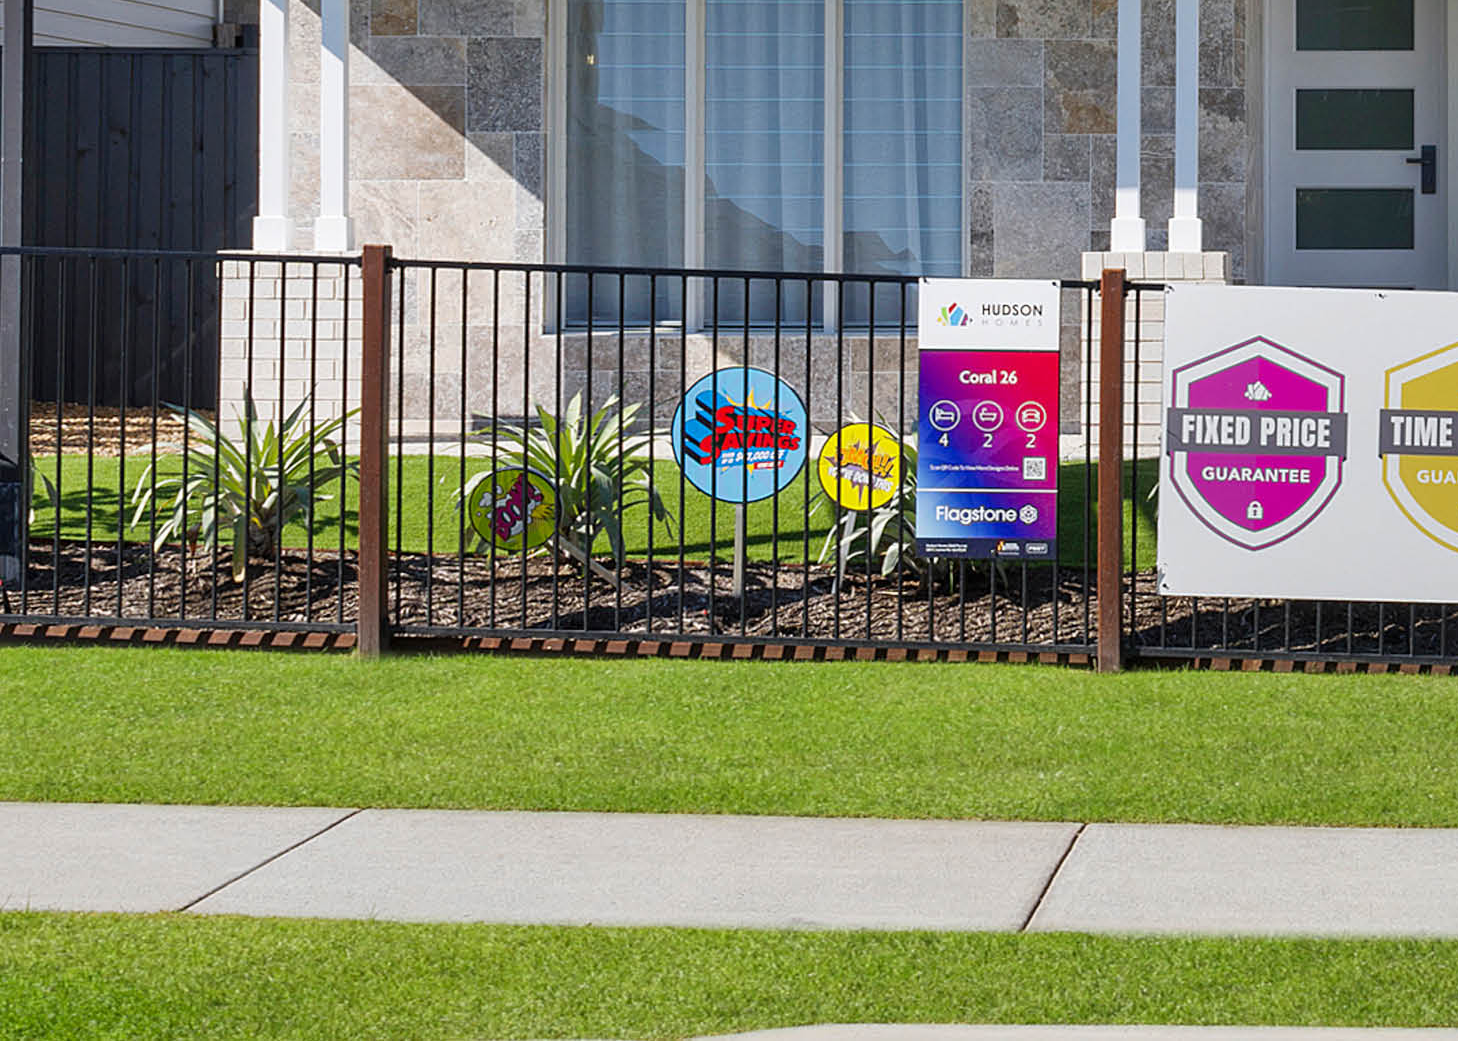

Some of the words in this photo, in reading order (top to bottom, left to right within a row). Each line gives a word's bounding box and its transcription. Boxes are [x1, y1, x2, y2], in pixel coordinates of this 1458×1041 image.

[981, 303, 1043, 316] HUDSON
[958, 369, 998, 384] Coral
[999, 370, 1019, 385] 26
[1181, 414, 1251, 446] FIXED
[1259, 416, 1331, 448] PRICE
[1390, 415, 1453, 448] TIME
[938, 432, 950, 448] 4
[982, 433, 994, 448] 2
[1025, 433, 1037, 449] 2
[1201, 466, 1311, 483] GUARANTEE
[935, 505, 1018, 525] Flagstone
